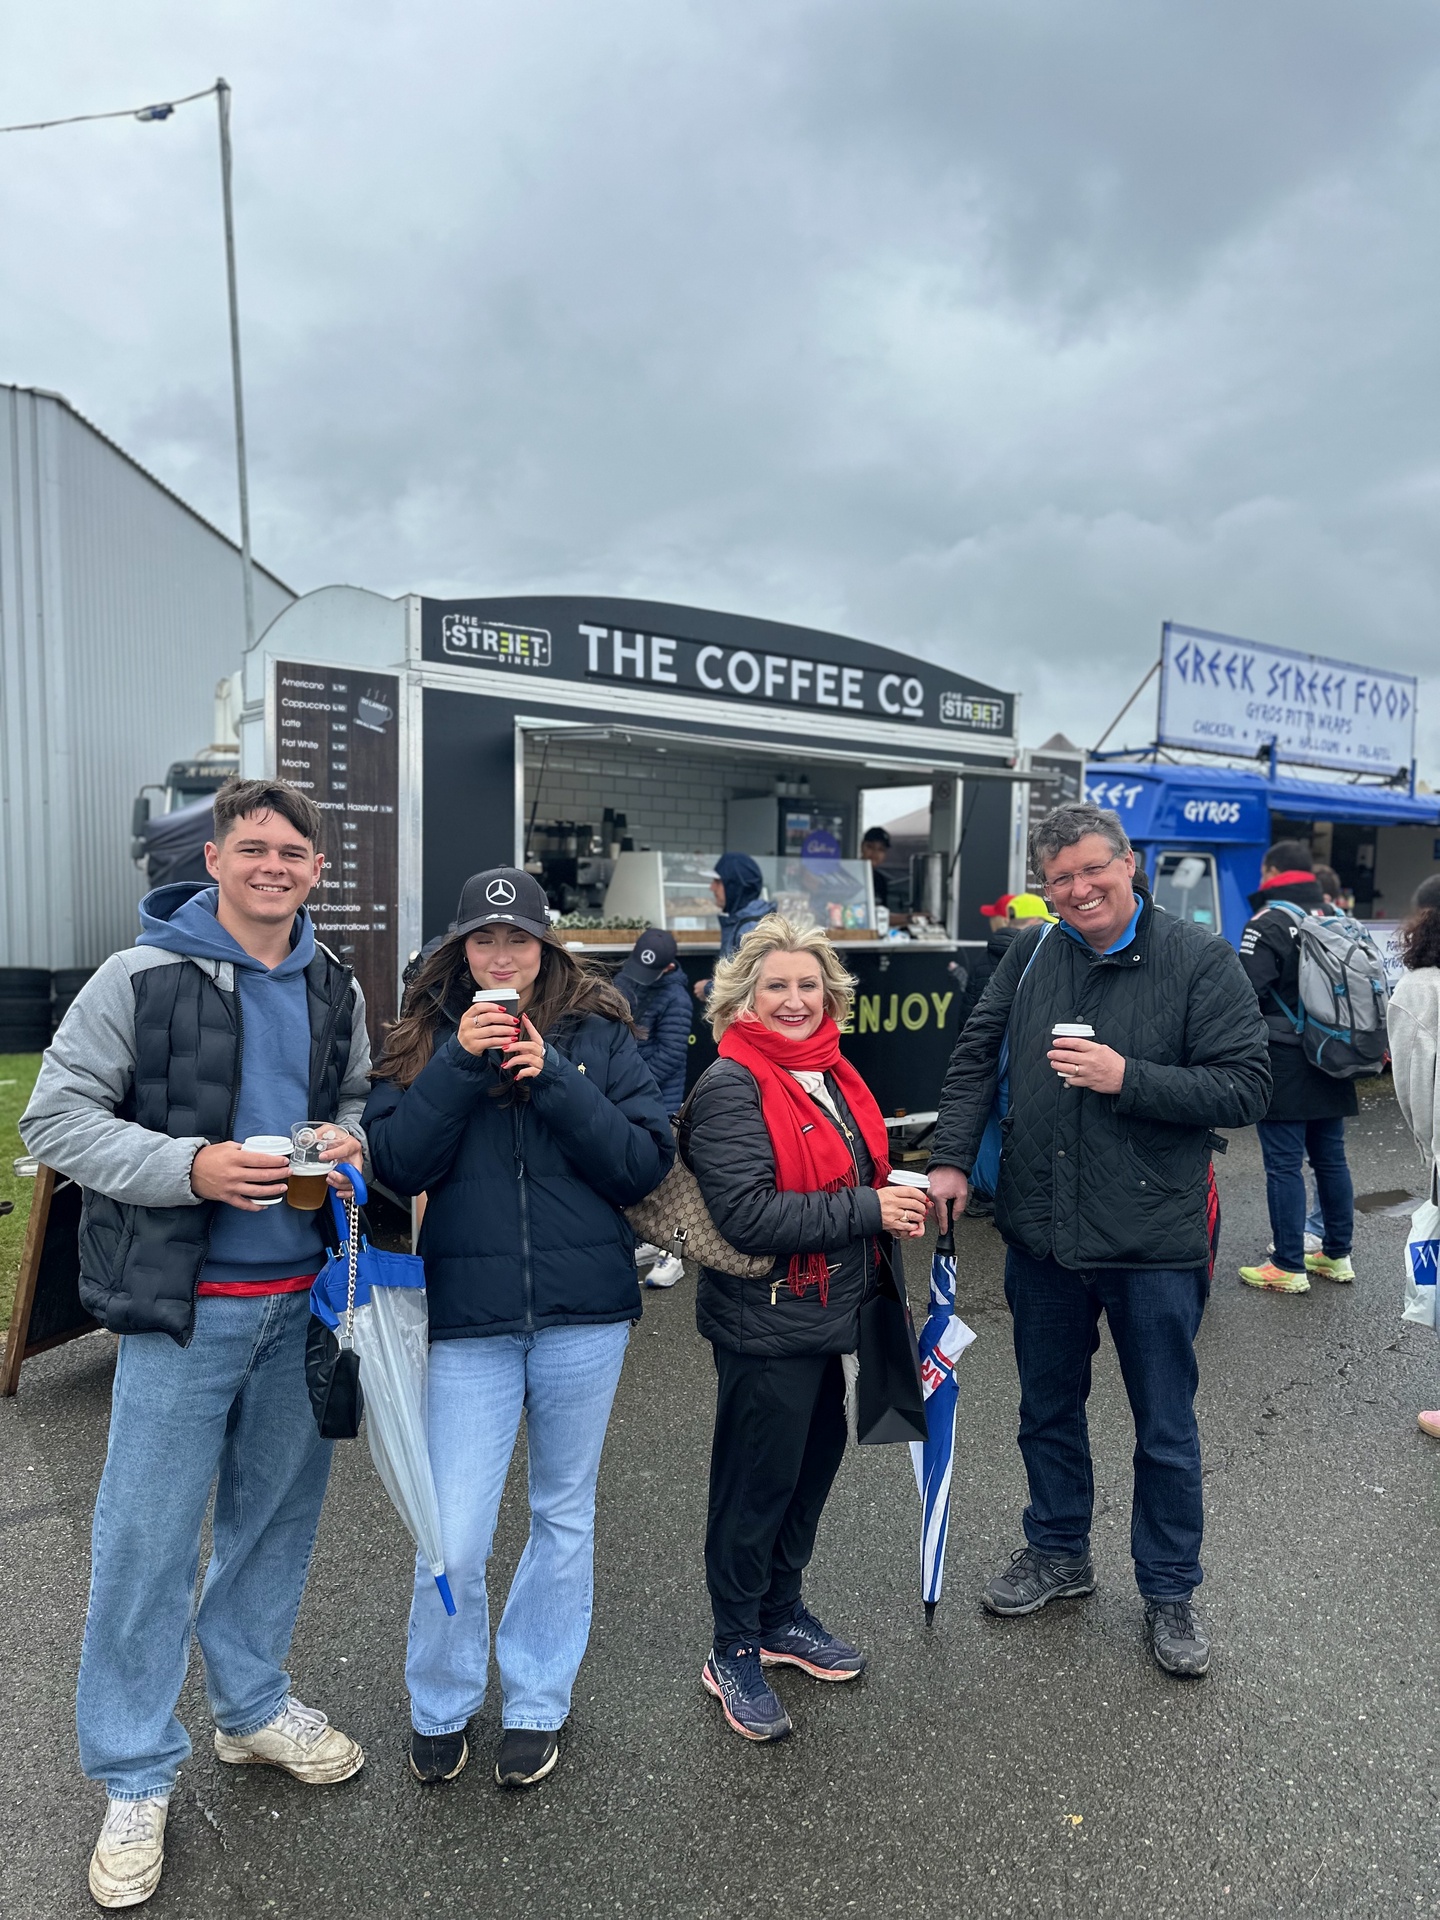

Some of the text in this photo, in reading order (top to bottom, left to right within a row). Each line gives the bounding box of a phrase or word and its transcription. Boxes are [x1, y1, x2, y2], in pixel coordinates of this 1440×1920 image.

[453, 614, 478, 626] THE
[451, 624, 544, 658] STREET
[498, 653, 540, 667] DINER
[578, 624, 677, 683] THE
[695, 645, 864, 709] COFFEE
[281, 677, 325, 691] Americano
[1174, 640, 1410, 722] GREEK STREET FOOD
[281, 697, 331, 711] Cappuccino
[944, 699, 1000, 723] STREET
[1245, 701, 1282, 723] GYROS
[281, 718, 301, 728] Latte
[281, 738, 296, 748] Flat
[297, 739, 319, 750] White
[281, 758, 311, 769] Mocha
[347, 803, 378, 812] Hazelnut
[1183, 800, 1241, 824] GYROS
[322, 880, 340, 888] Teas
[307, 904, 320, 912] Hot
[321, 904, 361, 912] Chocolate
[319, 923, 370, 931] Marshmallows
